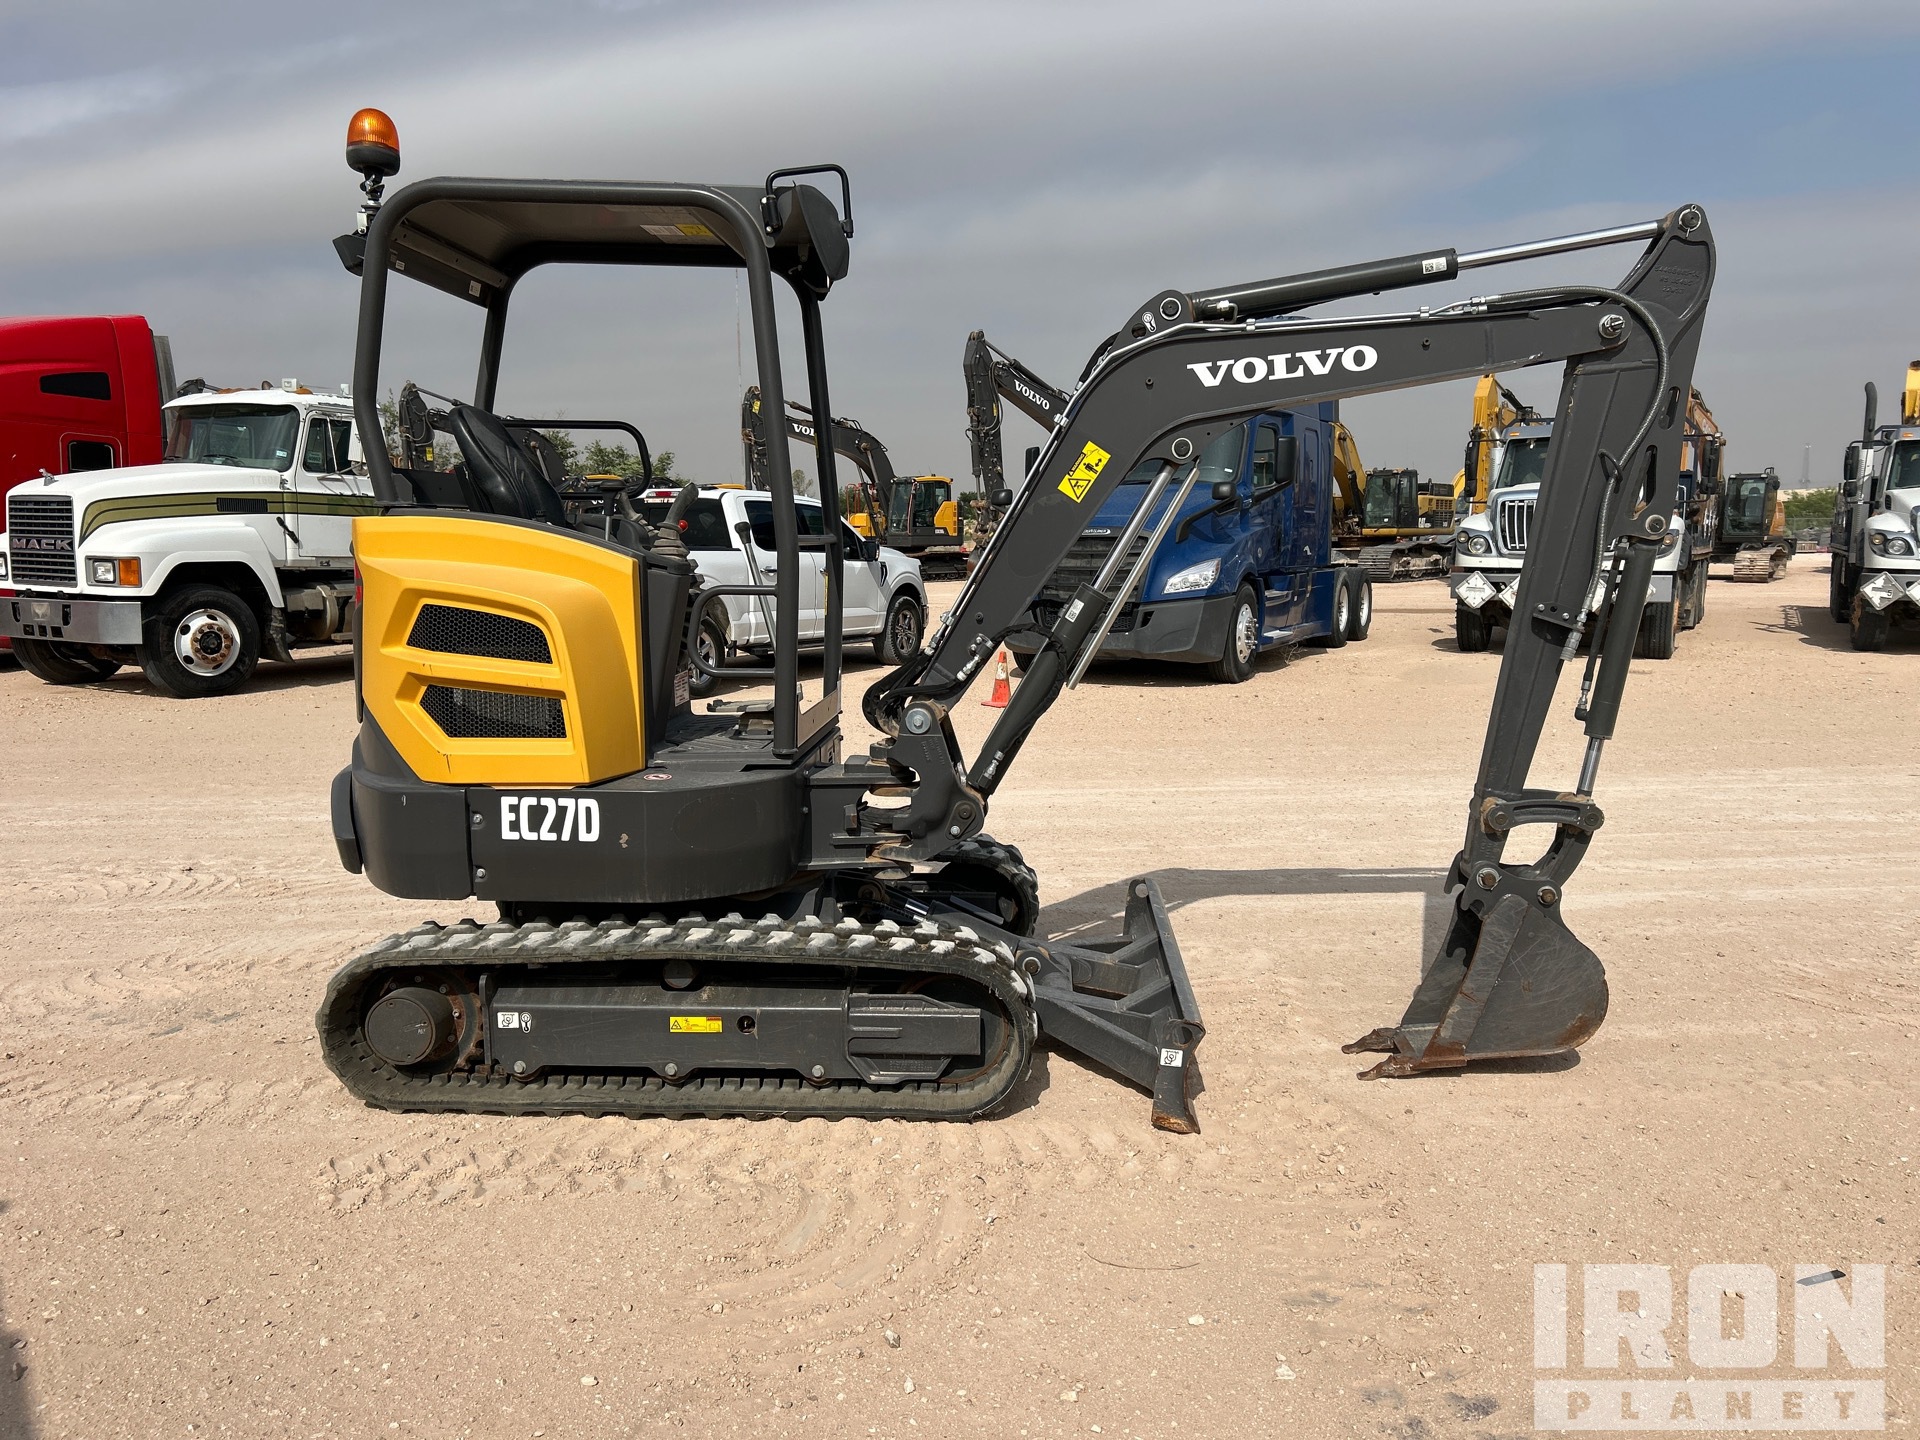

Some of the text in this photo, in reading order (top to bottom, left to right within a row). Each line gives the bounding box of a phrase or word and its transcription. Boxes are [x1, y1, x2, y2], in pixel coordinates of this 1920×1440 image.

[1187, 345, 1378, 387] VOLVO
[1014, 379, 1050, 410] VOLVO
[12, 538, 73, 551] MACK
[500, 796, 600, 842] EC27D
